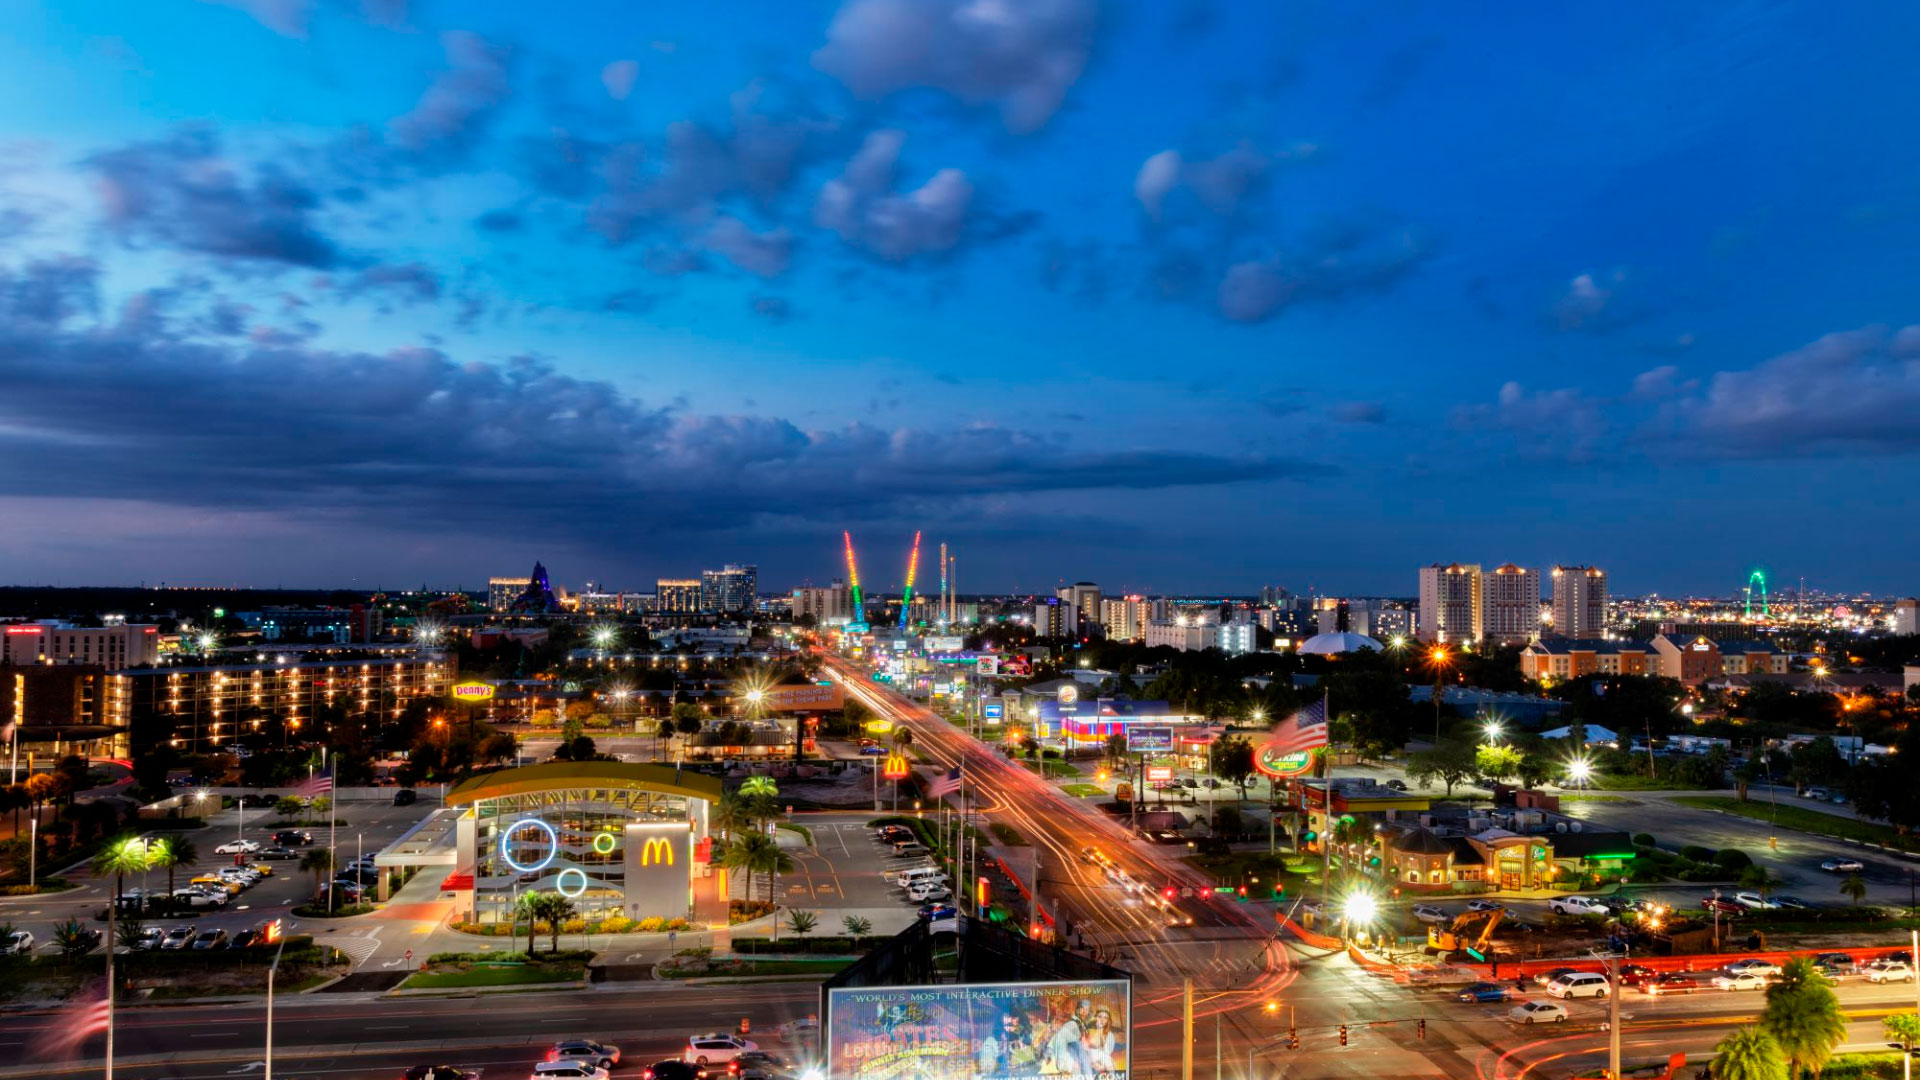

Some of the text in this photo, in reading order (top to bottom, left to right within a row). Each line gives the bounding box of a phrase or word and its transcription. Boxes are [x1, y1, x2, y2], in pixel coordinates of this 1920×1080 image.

[456, 685, 492, 697] Denny's
[910, 992, 942, 1001] MOST
[945, 990, 1019, 1001] INTERACTIVE
[1023, 988, 1066, 999] DINNER
